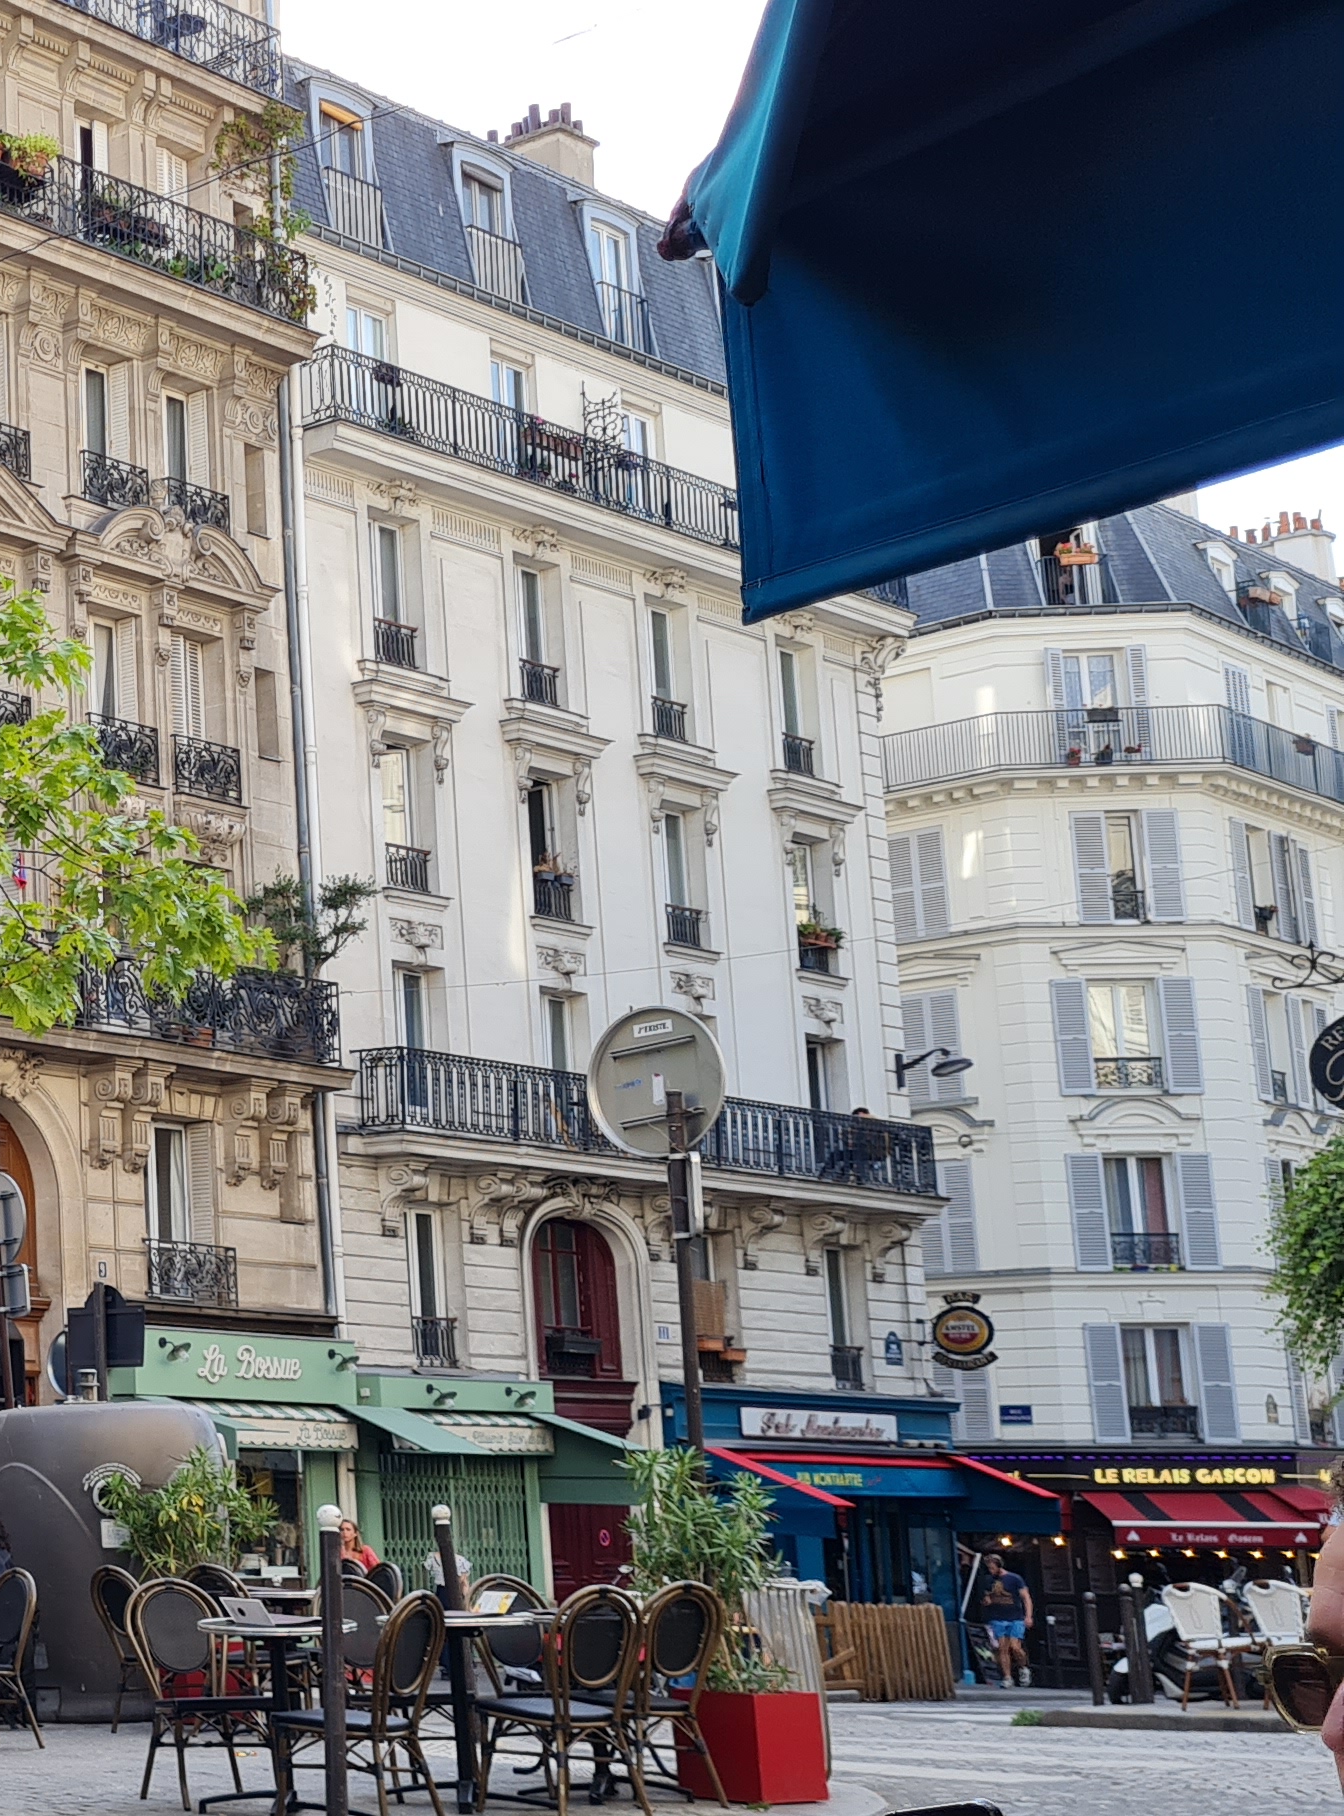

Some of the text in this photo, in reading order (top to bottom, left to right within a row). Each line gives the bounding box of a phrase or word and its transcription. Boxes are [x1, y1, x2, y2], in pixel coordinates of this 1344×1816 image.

[99, 1262, 106, 1277] 9
[197, 1344, 303, 1383] La Bossue
[297, 1423, 311, 1443] La
[1093, 1468, 1276, 1485] LE RELAIS GASCON
